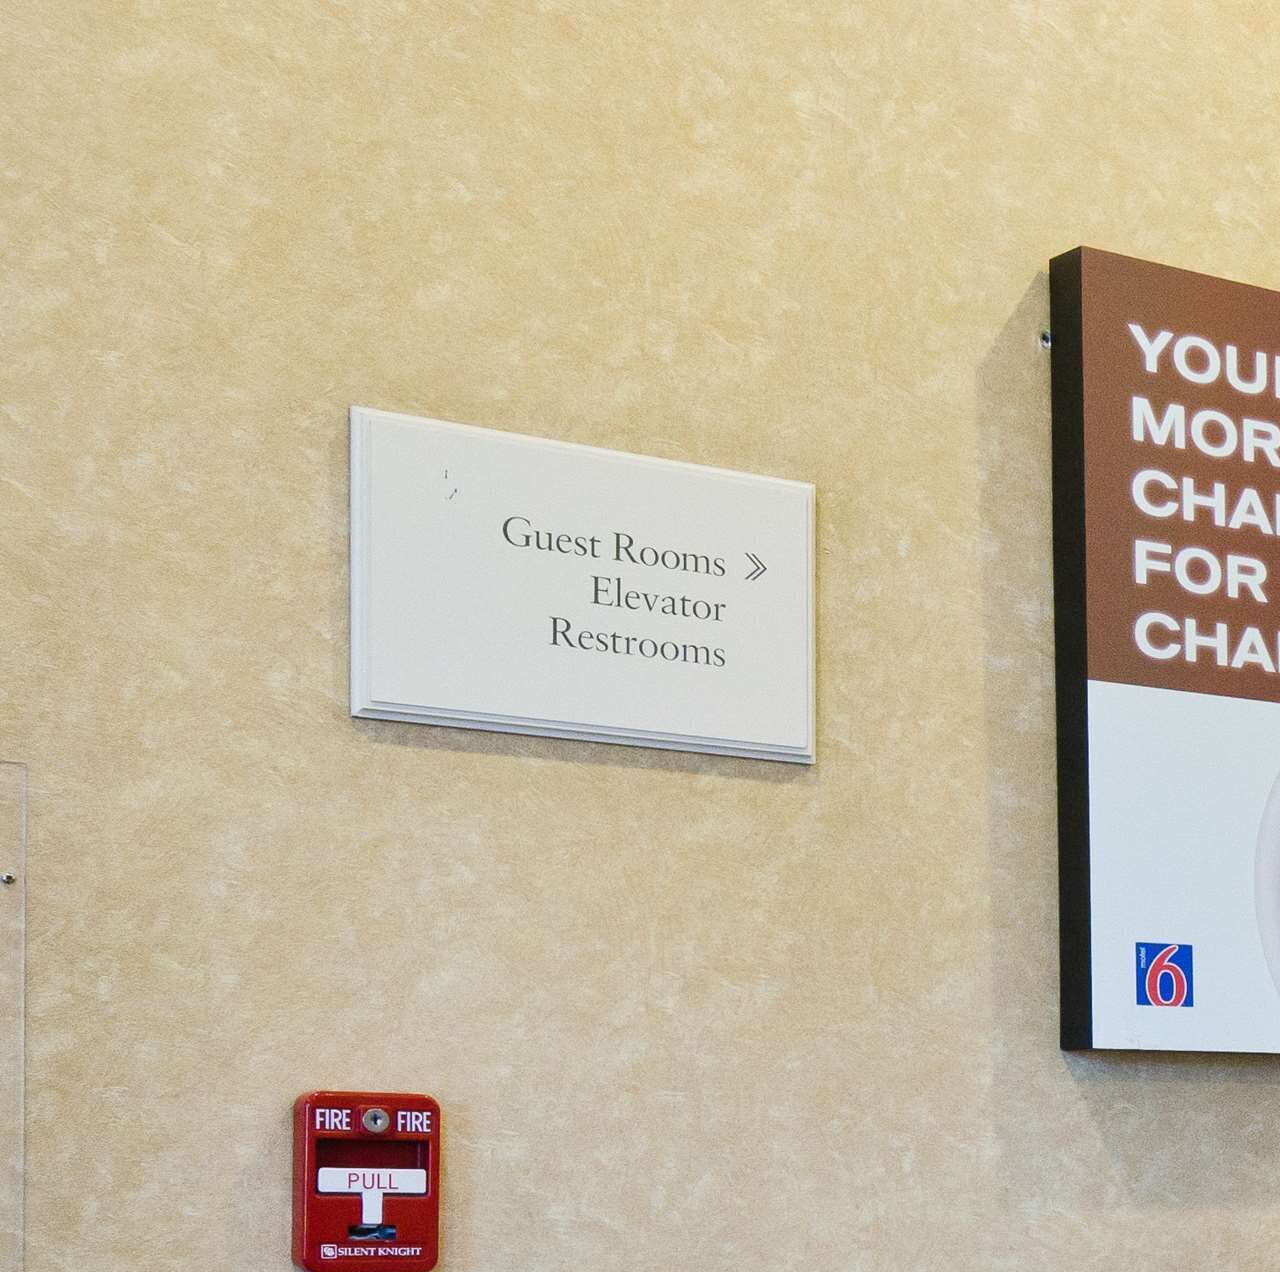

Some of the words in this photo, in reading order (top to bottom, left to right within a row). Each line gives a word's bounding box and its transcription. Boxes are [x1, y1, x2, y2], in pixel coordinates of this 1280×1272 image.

[502, 515, 601, 560] Guest
[612, 531, 727, 578] Rooms
[1133, 539, 1269, 604] FOR
[590, 574, 727, 623] Elevator
[550, 616, 727, 668] Restrooms
[1146, 945, 1188, 1007] 6
[315, 1108, 351, 1131] FIRE
[396, 1110, 432, 1133] FIRE
[347, 1172, 399, 1190] PULL
[338, 1247, 376, 1256] SILENT
[377, 1247, 422, 1256] KNIGHT
